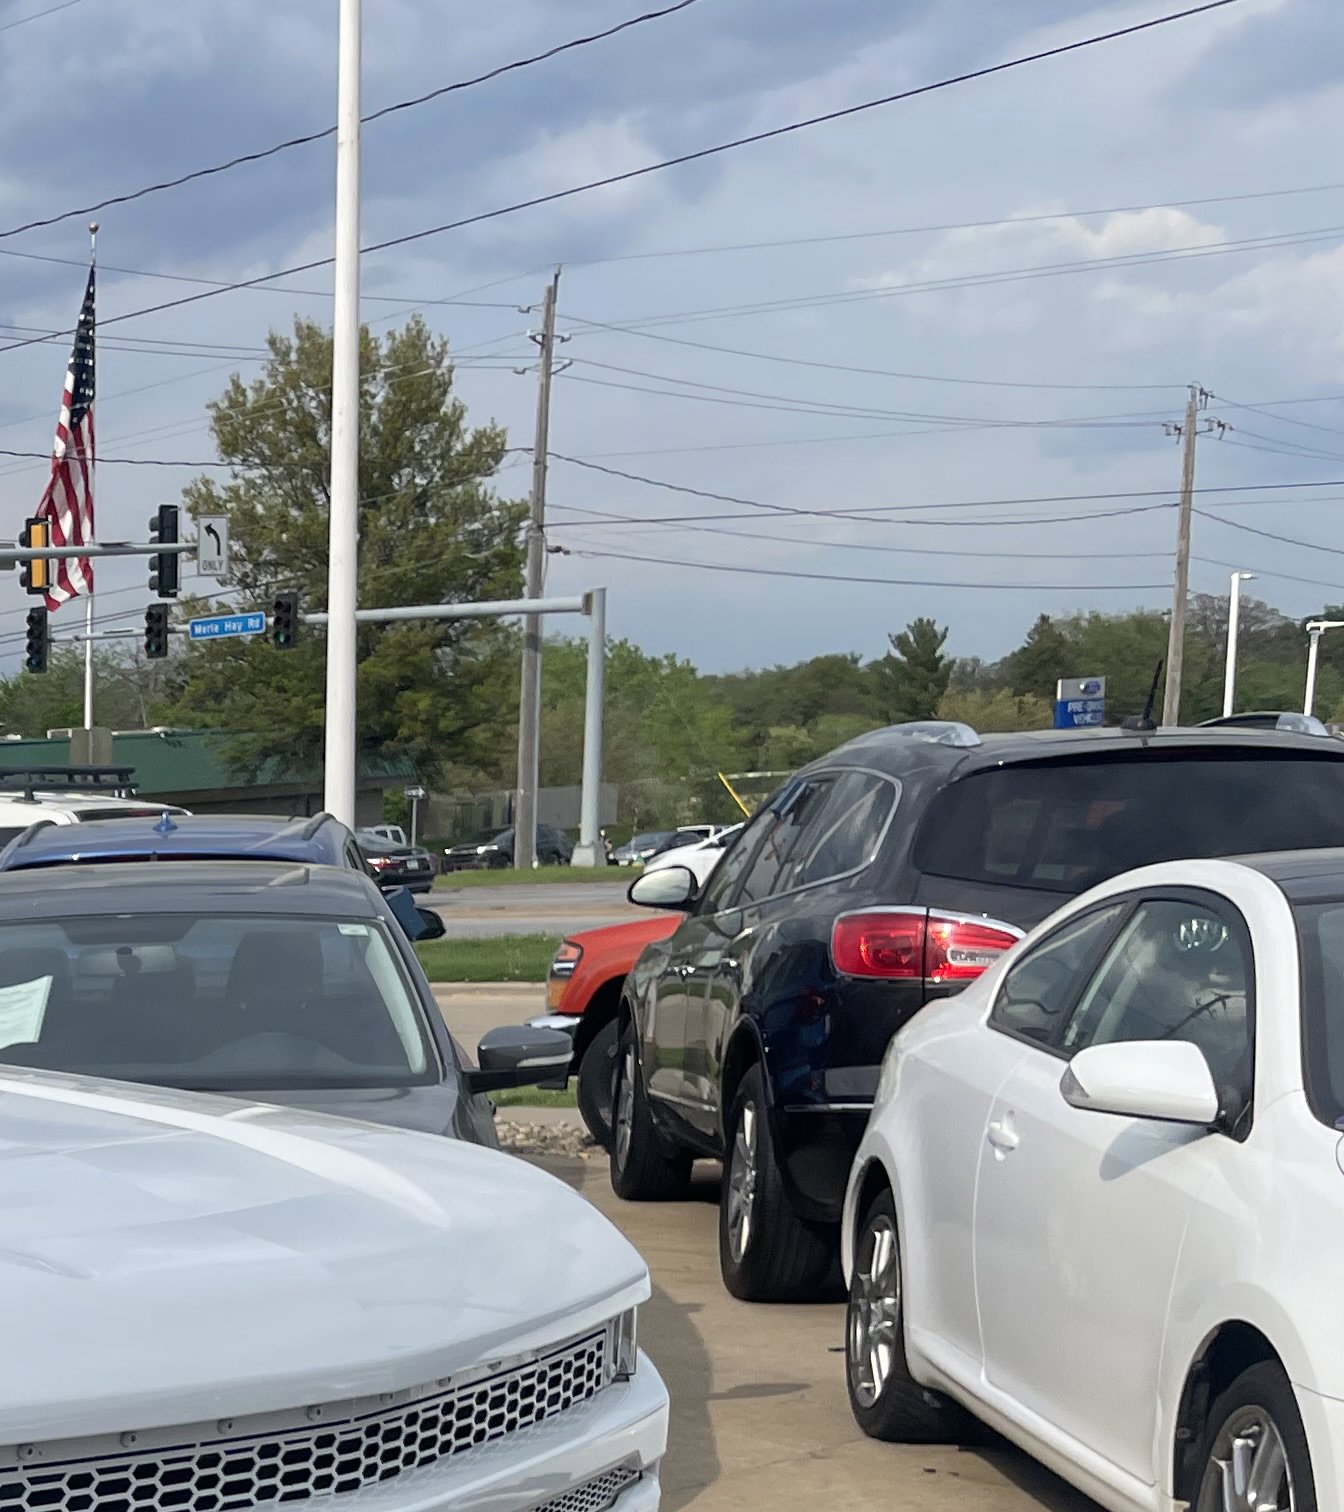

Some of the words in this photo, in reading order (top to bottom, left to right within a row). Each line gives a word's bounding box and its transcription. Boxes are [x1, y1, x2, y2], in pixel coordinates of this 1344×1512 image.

[201, 559, 224, 571] ONLY
[224, 620, 243, 632] Hay
[247, 617, 260, 629] Rd
